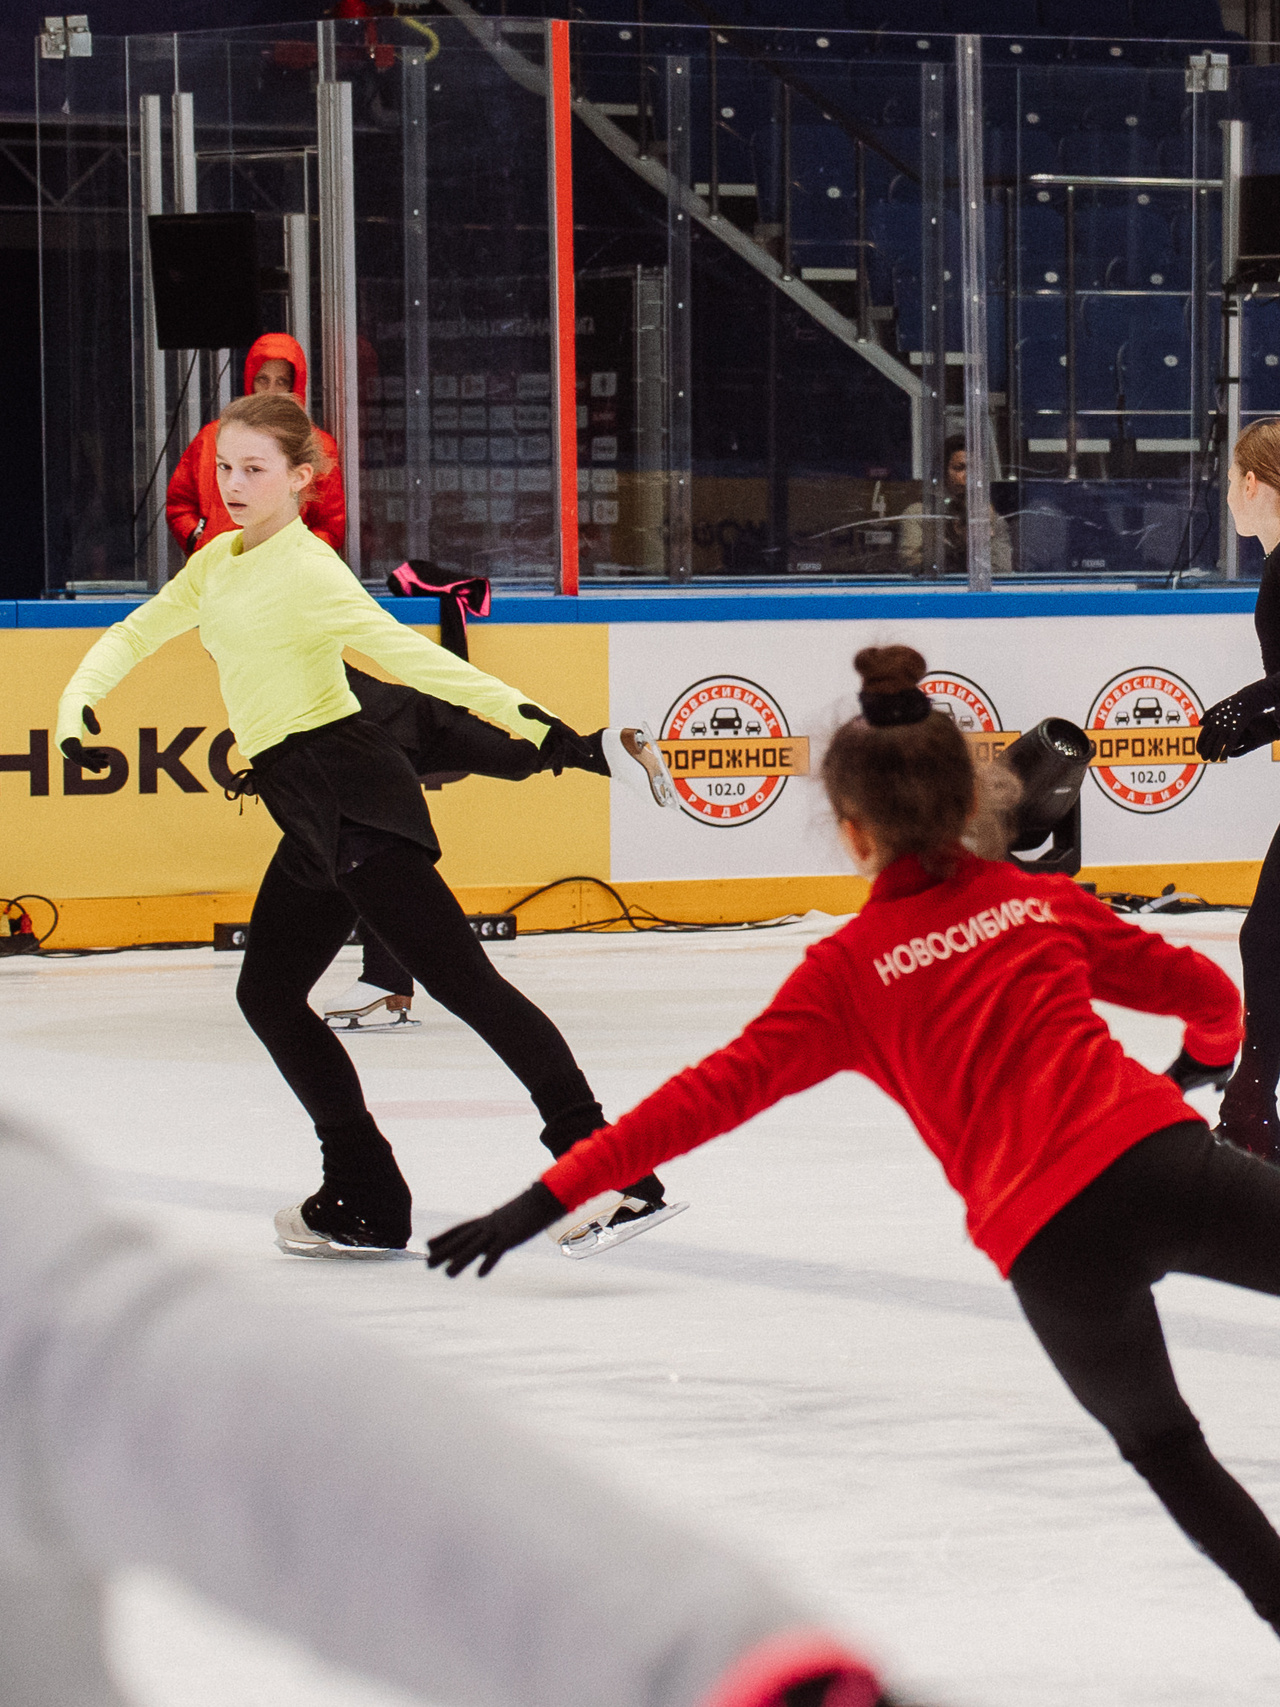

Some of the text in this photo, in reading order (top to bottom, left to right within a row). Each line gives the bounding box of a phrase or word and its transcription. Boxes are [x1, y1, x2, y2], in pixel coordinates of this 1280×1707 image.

[673, 686, 778, 731] НОВОСИБИРСК
[1097, 677, 1195, 722] НОВОСИБИРСК
[707, 782, 746, 796] 102.0
[1130, 770, 1167, 784] 102.0
[687, 791, 765, 818] РАДИО
[1111, 779, 1185, 805] РАДИО
[873, 897, 1059, 986] НОВОСИБИРСК
